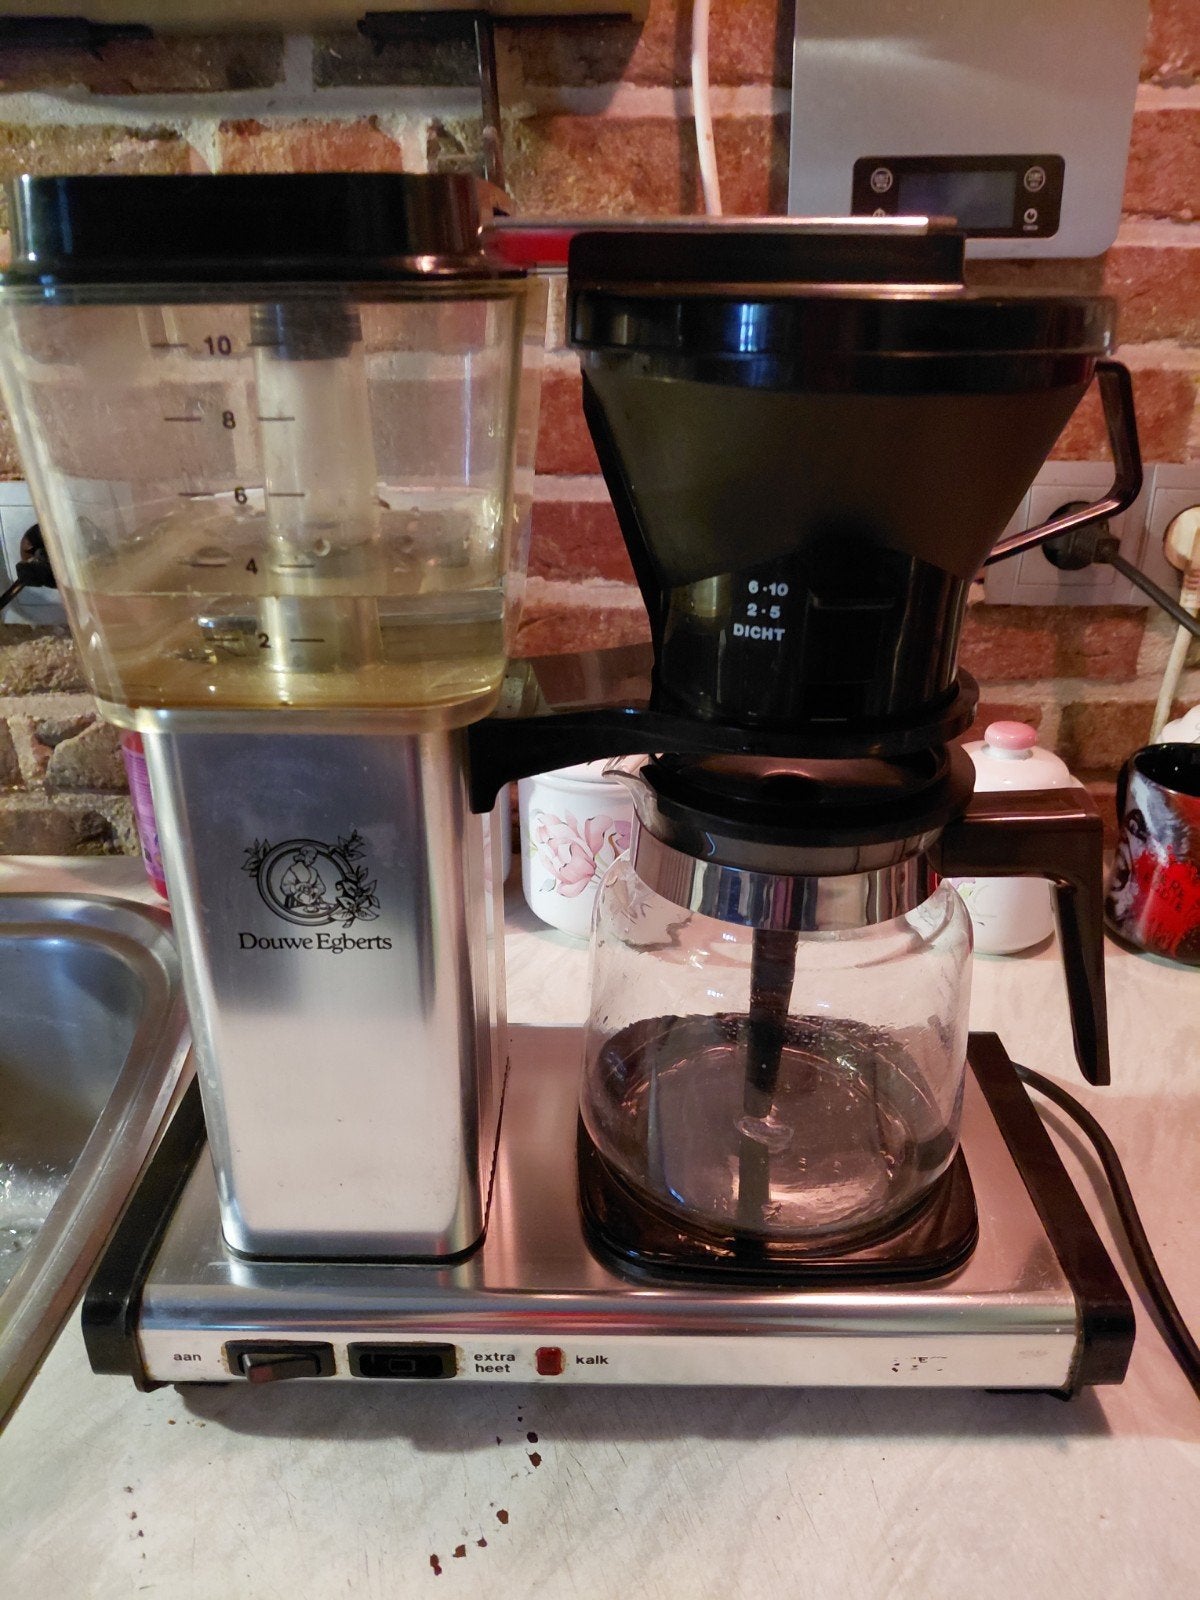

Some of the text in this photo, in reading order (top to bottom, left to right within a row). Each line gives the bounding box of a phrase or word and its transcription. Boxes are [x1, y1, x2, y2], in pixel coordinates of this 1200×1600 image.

[203, 335, 231, 356] 10
[222, 410, 236, 429] 8
[234, 486, 248, 505] 6
[245, 558, 258, 575] 4
[733, 622, 786, 641] DICHT
[257, 633, 271, 649] 2
[238, 932, 393, 954] Douwe Egberts
[173, 1353, 202, 1361] aan
[473, 1352, 516, 1362] extra
[575, 1354, 609, 1365] kalk
[475, 1363, 511, 1373] heet
